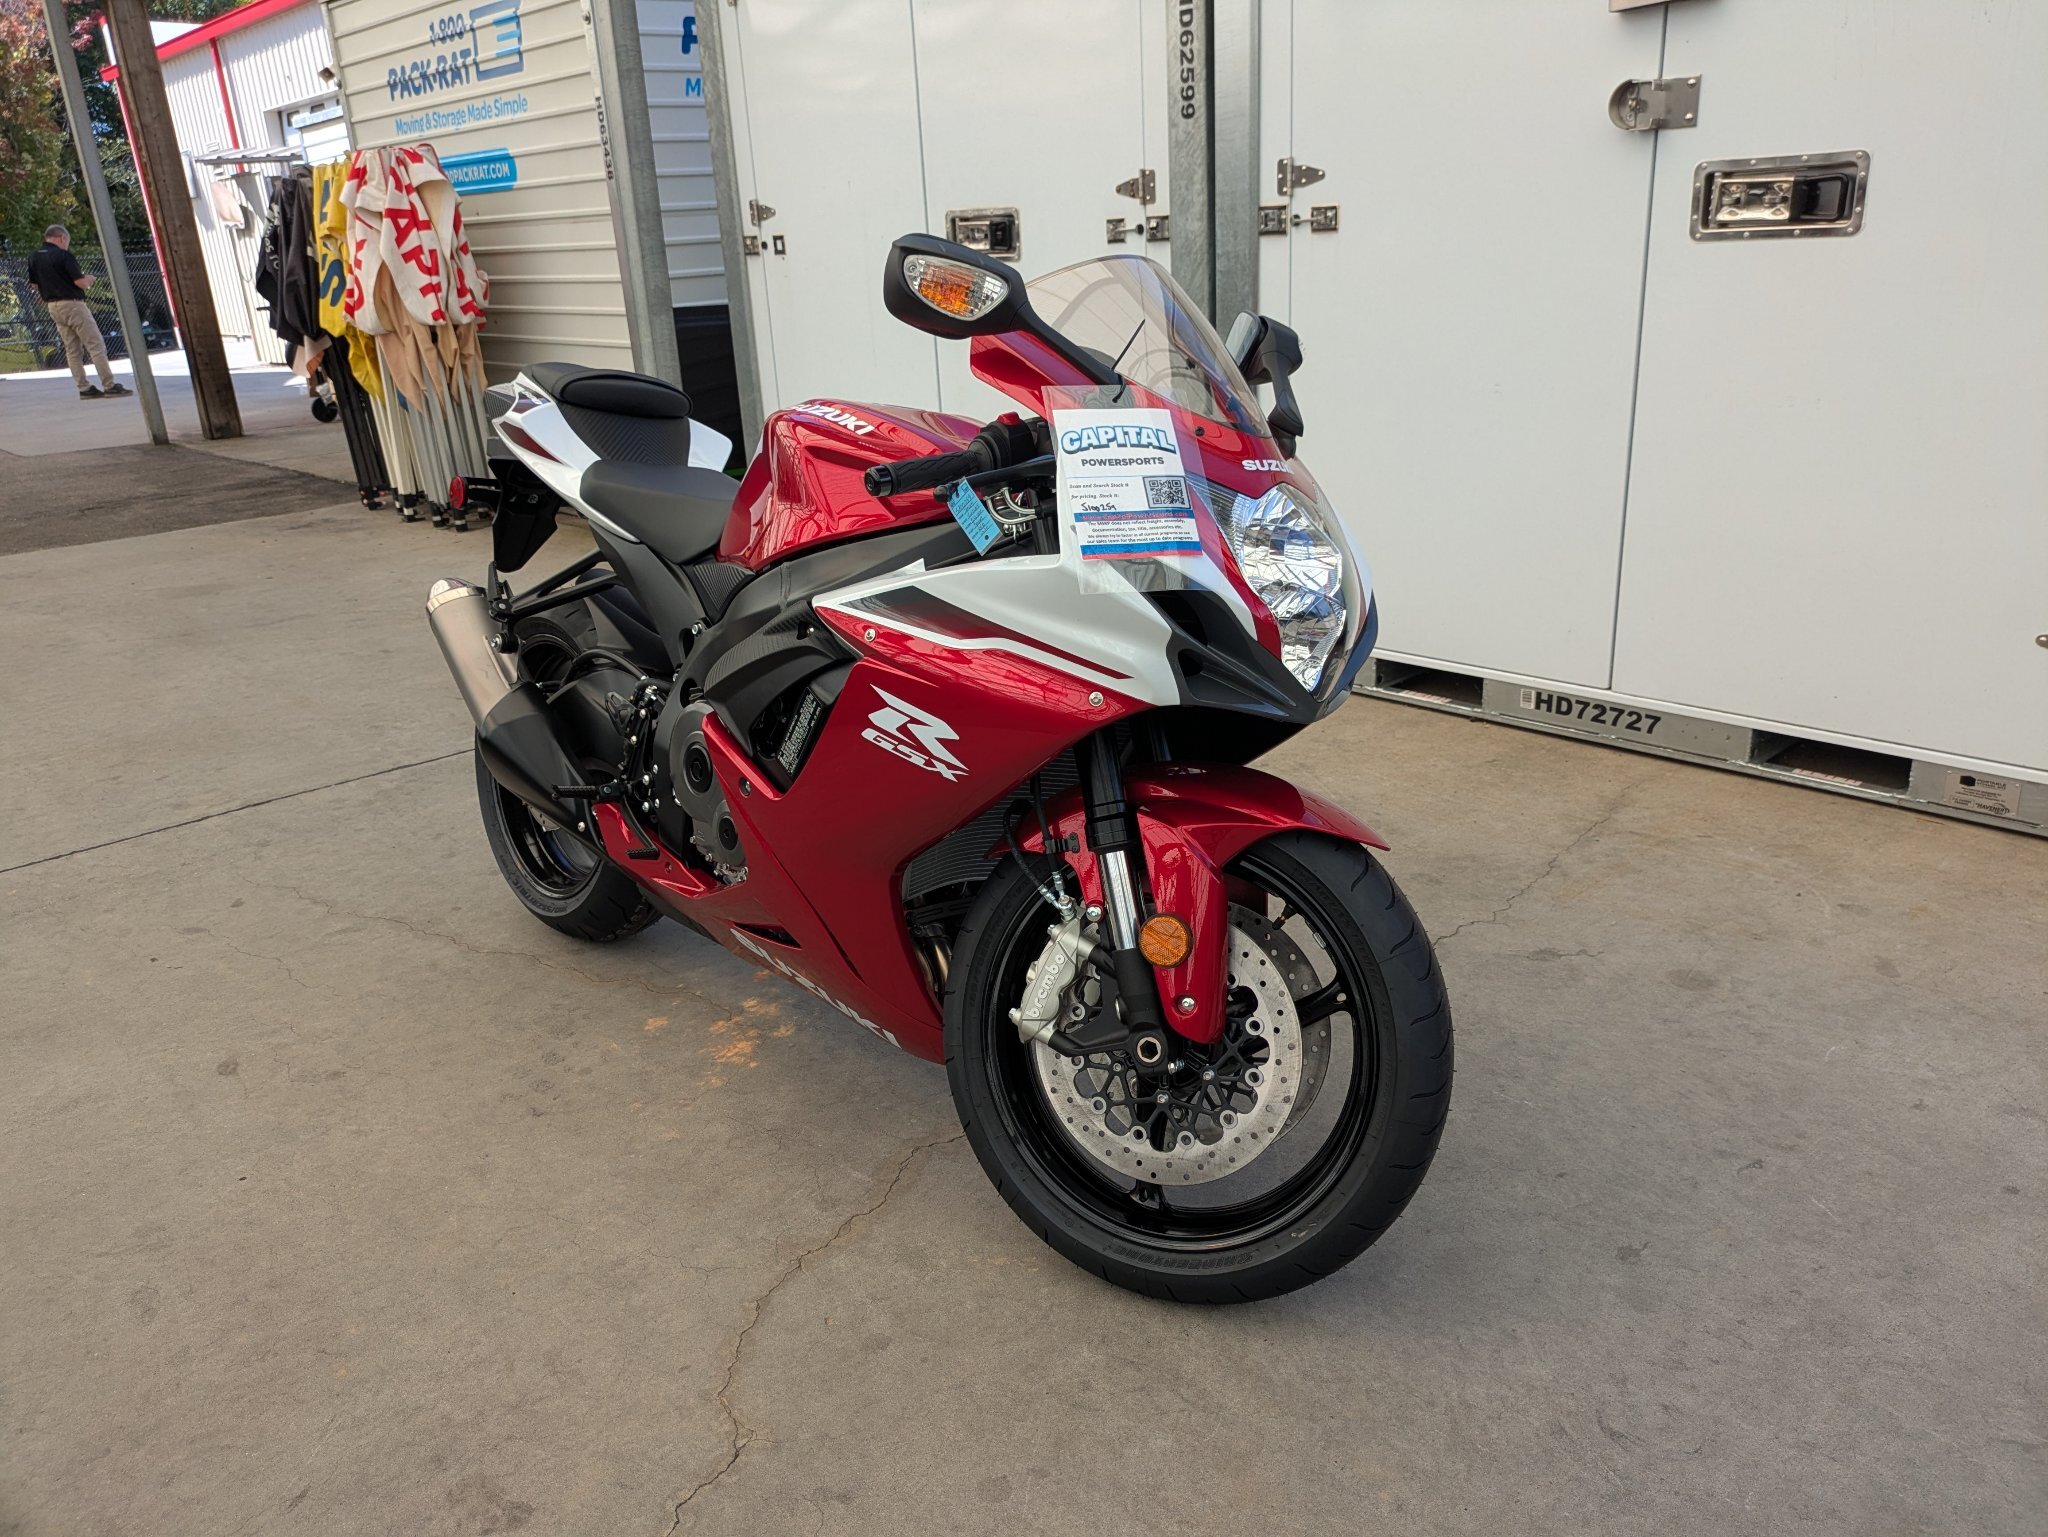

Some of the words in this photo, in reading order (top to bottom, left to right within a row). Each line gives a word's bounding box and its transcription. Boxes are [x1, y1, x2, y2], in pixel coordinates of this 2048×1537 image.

[387, 48, 472, 101] PACK-RAT
[395, 115, 424, 137] Moving
[425, 112, 432, 130] &
[432, 109, 466, 131] Storage
[467, 101, 493, 122] Made
[494, 94, 528, 121] Simple
[1061, 426, 1177, 454] CAPITAL
[1081, 457, 1165, 467] POWERSPORTS
[1241, 459, 1294, 475] SUZU
[1535, 691, 1662, 735] HD72727
[861, 727, 969, 782] GSX
[1025, 953, 1065, 1019] brembo
